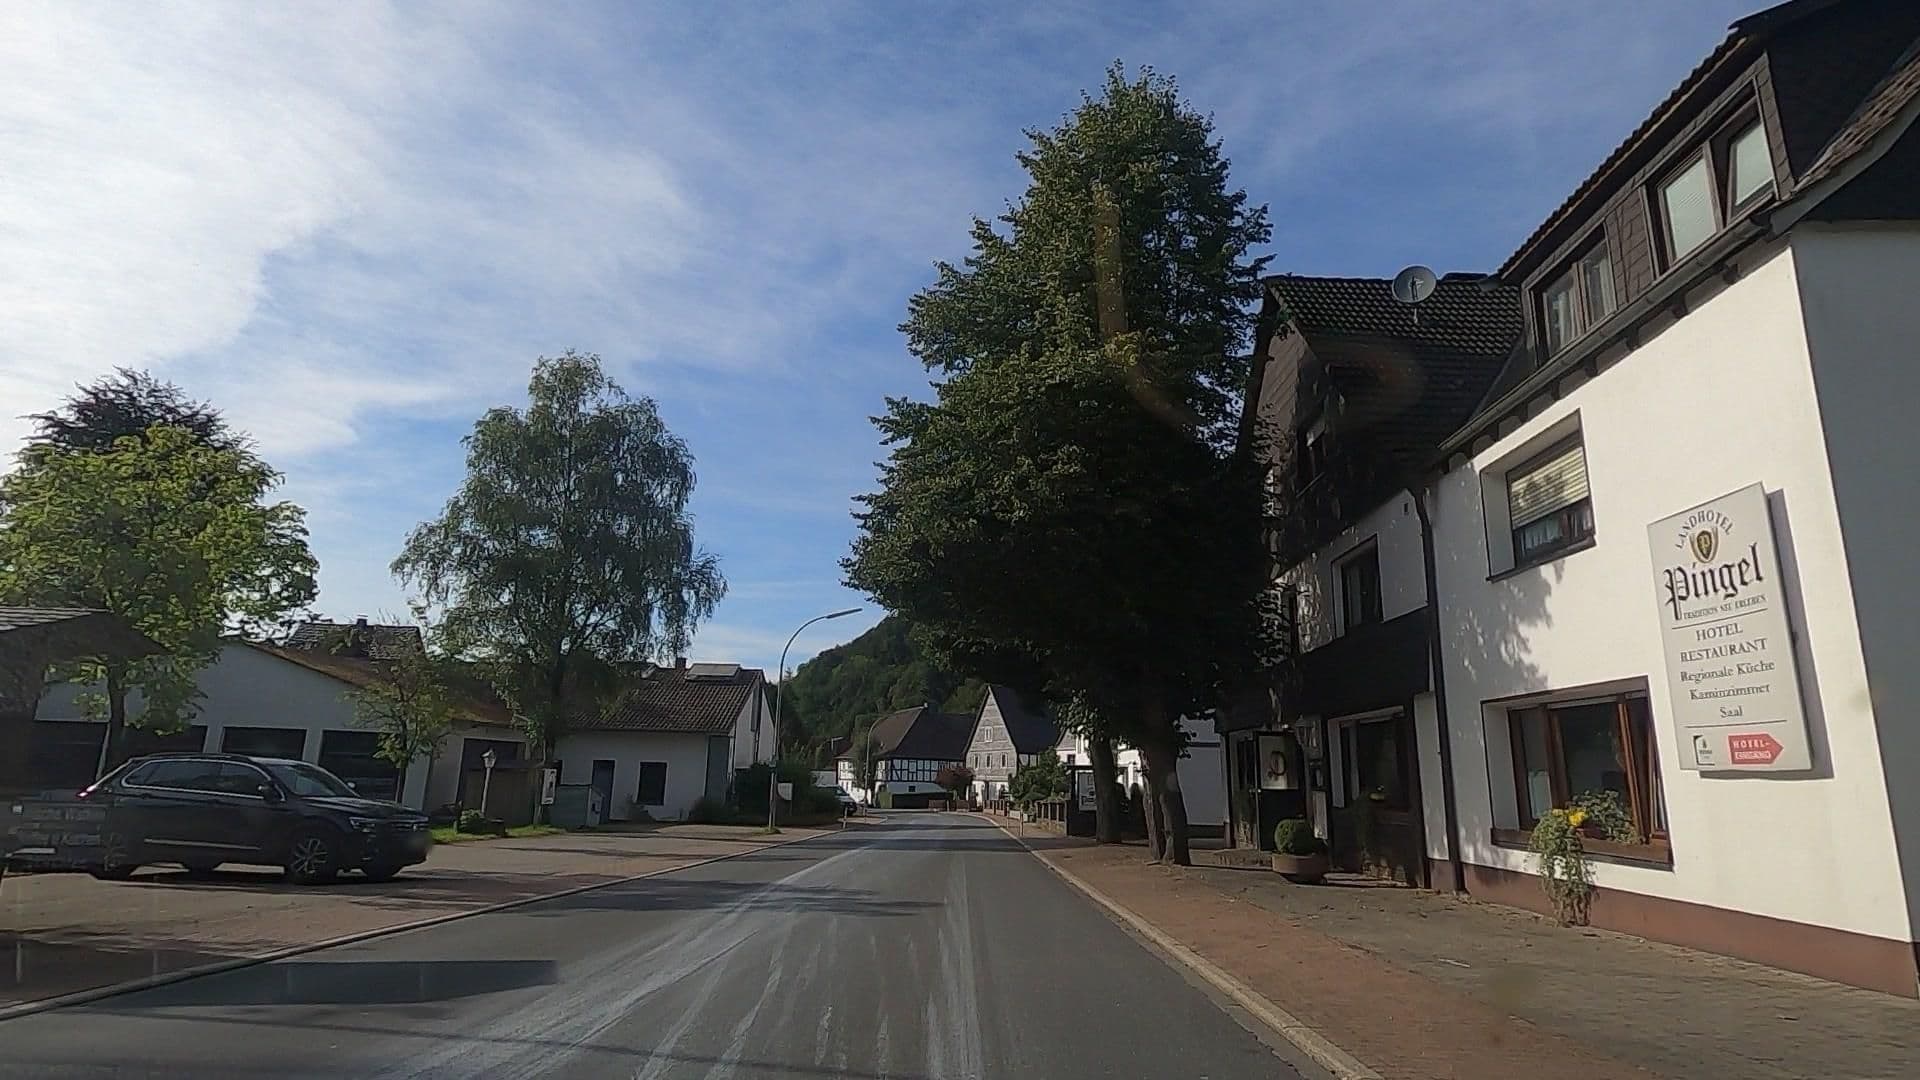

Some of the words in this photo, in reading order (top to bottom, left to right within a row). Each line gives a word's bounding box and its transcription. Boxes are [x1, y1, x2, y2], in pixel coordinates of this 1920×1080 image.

[1664, 542, 1763, 620] Pingel
[1695, 623, 1743, 641] HOTEL
[1680, 638, 1768, 662] RESTAURANT
[1680, 665, 1734, 684] Regionale
[1736, 660, 1775, 675] Küche
[1689, 684, 1770, 700] Kaminzimmer
[1719, 705, 1743, 718] Saal
